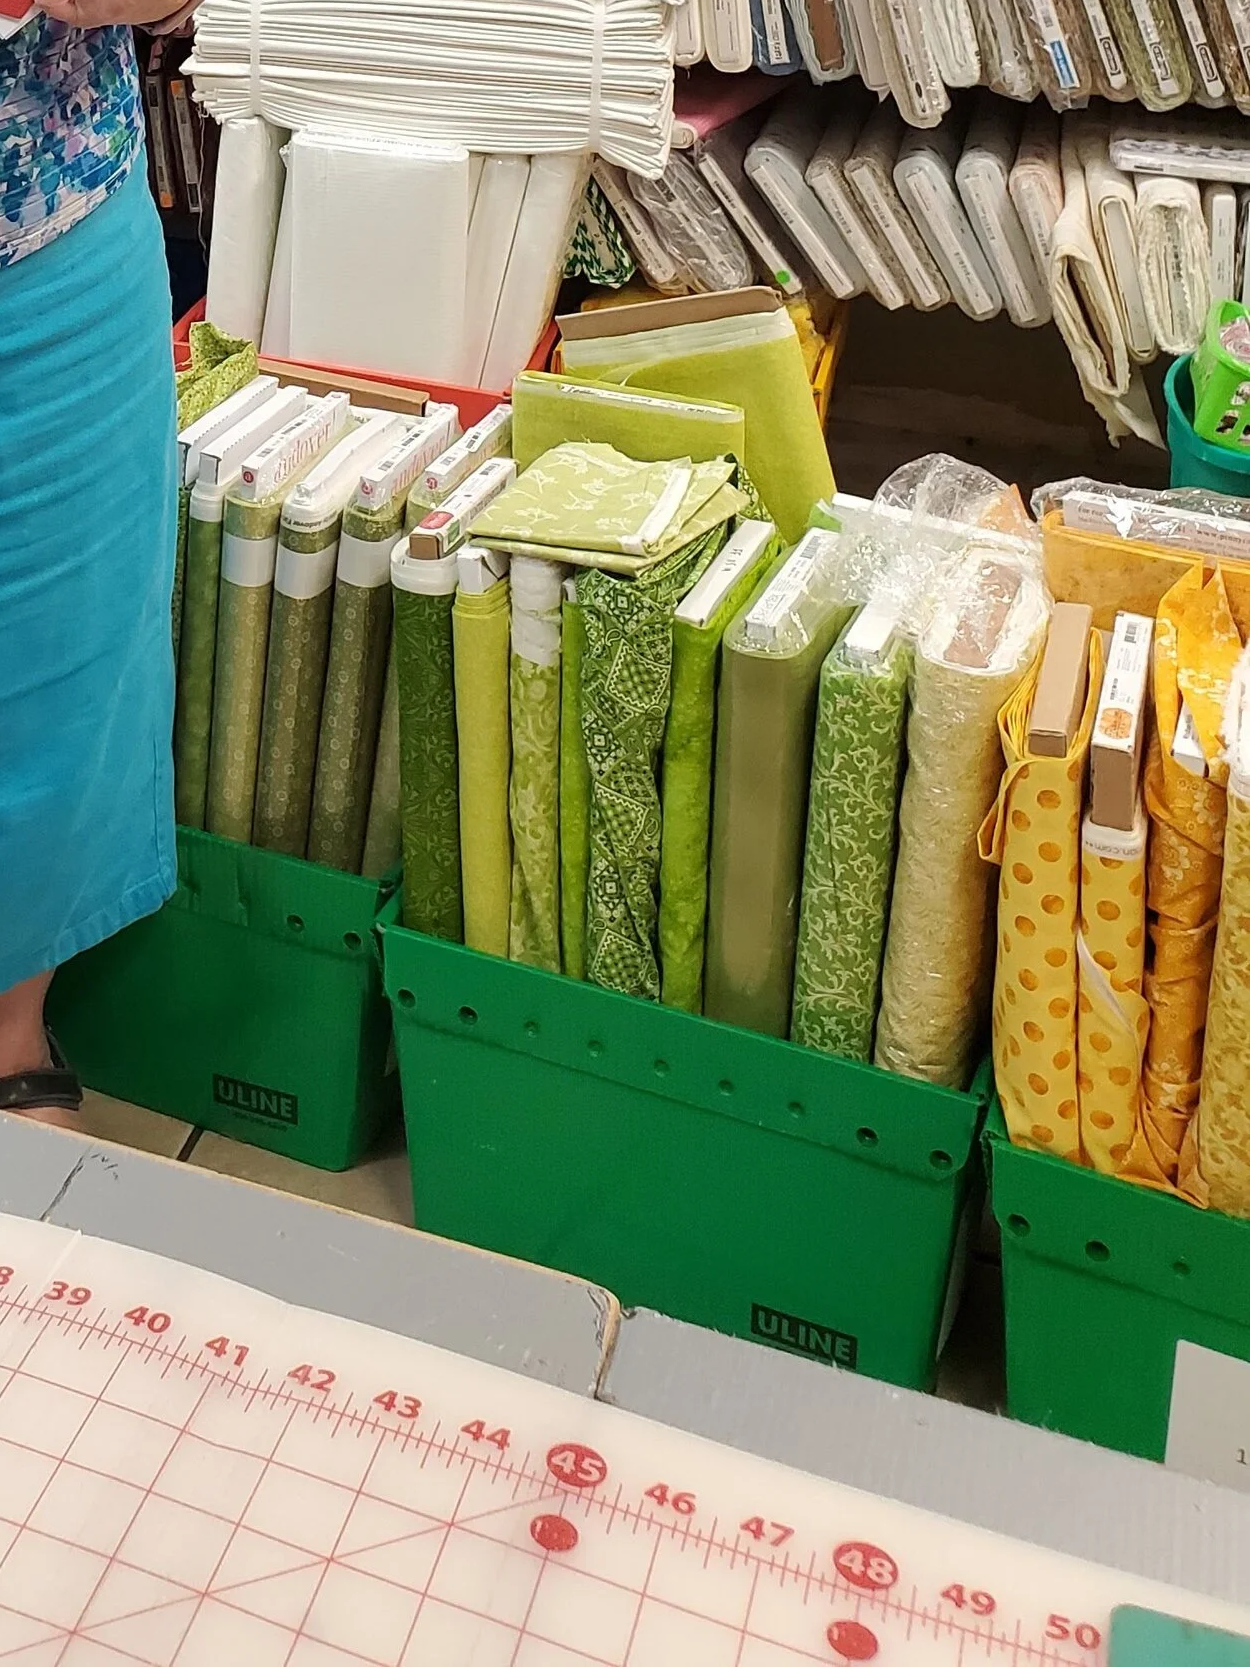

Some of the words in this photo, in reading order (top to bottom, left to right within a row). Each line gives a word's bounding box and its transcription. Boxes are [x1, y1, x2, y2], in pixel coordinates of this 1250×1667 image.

[273, 422, 332, 484] andover
[217, 1078, 294, 1120] ULINE
[755, 1309, 853, 1363] ULINE
[43, 1280, 92, 1308] 39
[123, 1305, 172, 1335] 40
[205, 1335, 250, 1367] 41
[286, 1363, 337, 1393] 42
[372, 1390, 423, 1420] 43
[460, 1419, 512, 1451] 44
[549, 1449, 602, 1481] 45
[643, 1481, 697, 1516] 46
[739, 1515, 795, 1548] 47
[837, 1550, 895, 1584] 48
[940, 1582, 998, 1617] 49
[1044, 1612, 1102, 1650] 50
